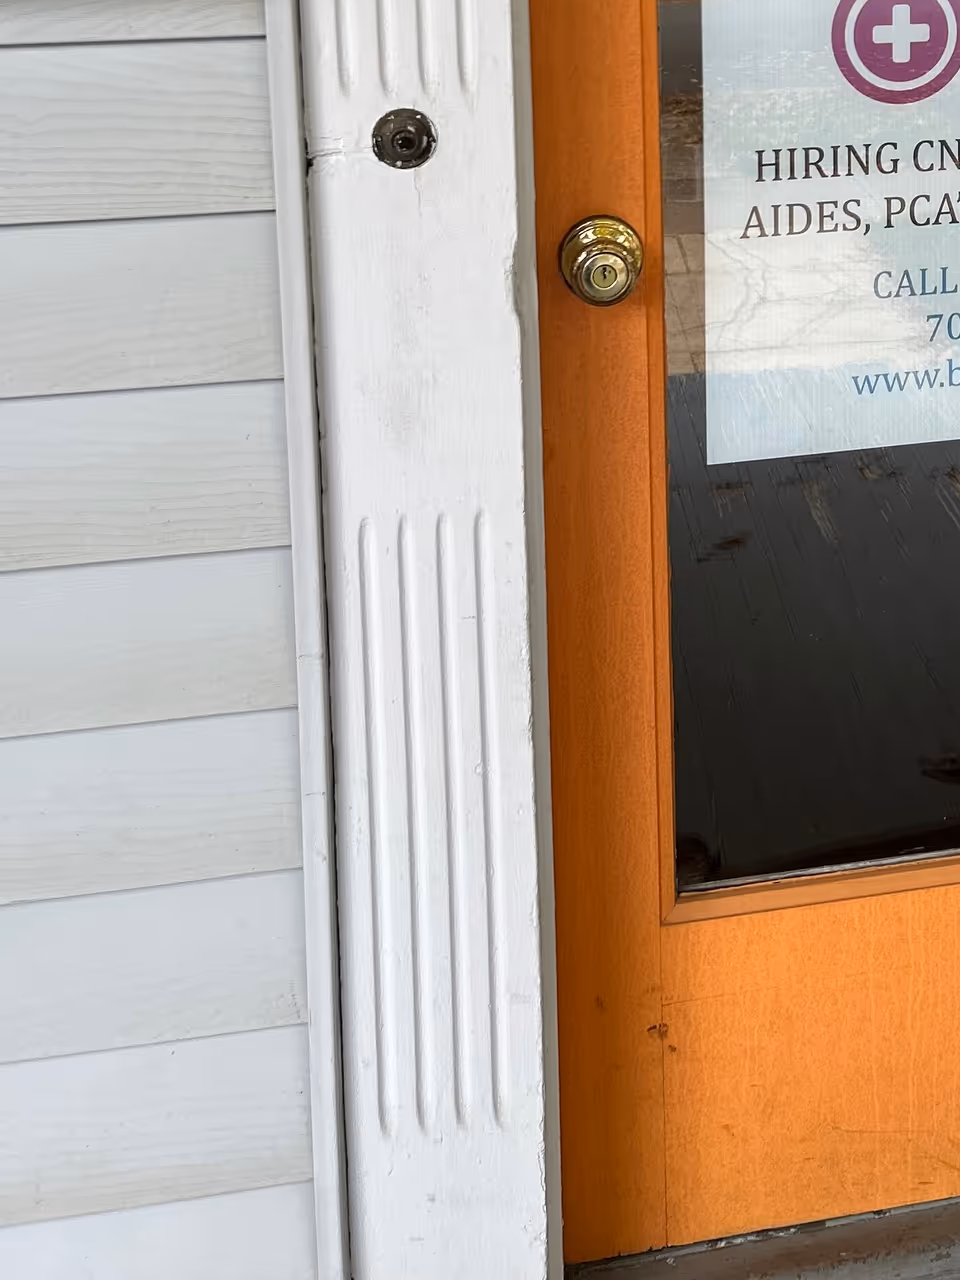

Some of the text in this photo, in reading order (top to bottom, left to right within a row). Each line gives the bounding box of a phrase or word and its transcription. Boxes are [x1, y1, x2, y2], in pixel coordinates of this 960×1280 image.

[755, 140, 900, 183] HIRING
[740, 198, 871, 239] AIDES,
[873, 266, 959, 300] CALL
